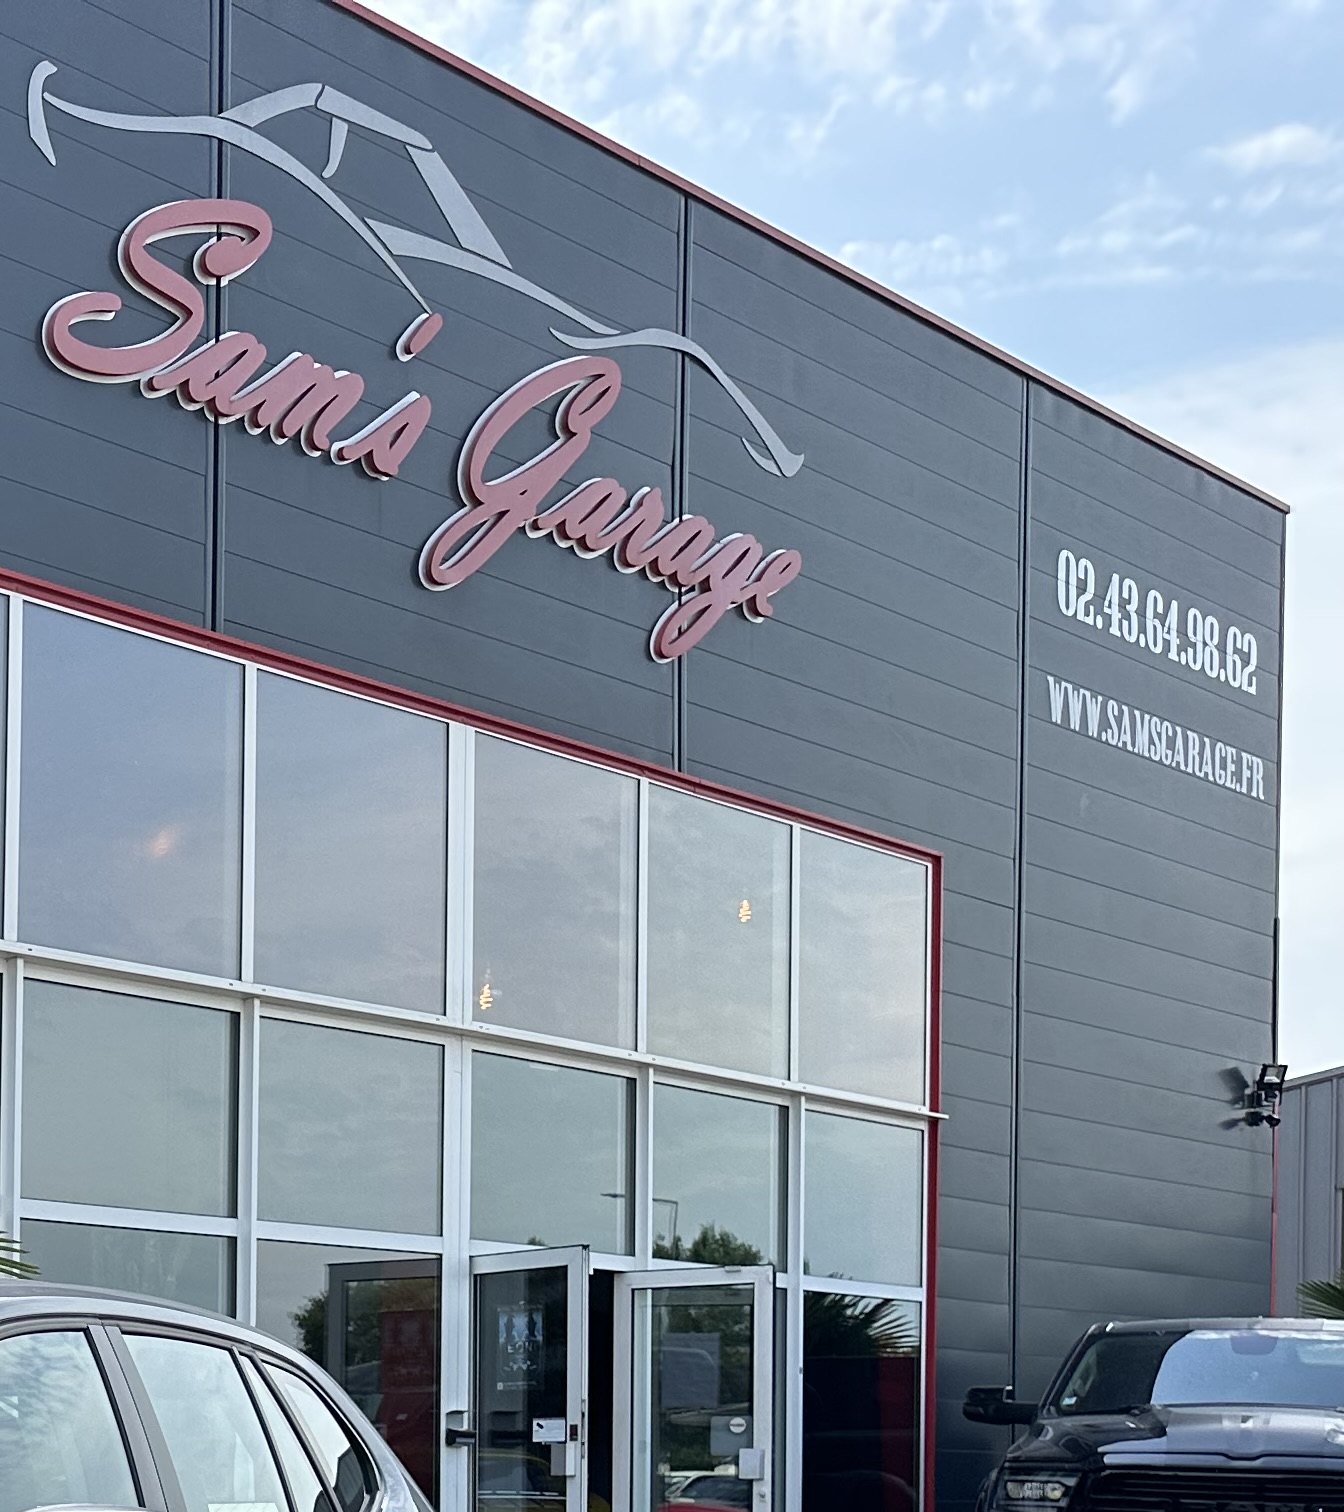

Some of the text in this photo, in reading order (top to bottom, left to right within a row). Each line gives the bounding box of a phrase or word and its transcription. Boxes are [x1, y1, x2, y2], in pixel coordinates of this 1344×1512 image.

[41, 199, 802, 665] Sam's Garage
[1057, 549, 1257, 696] 02.43.64.98.62
[1046, 675, 1265, 801] WWW.SAMSGARAGE.FR
